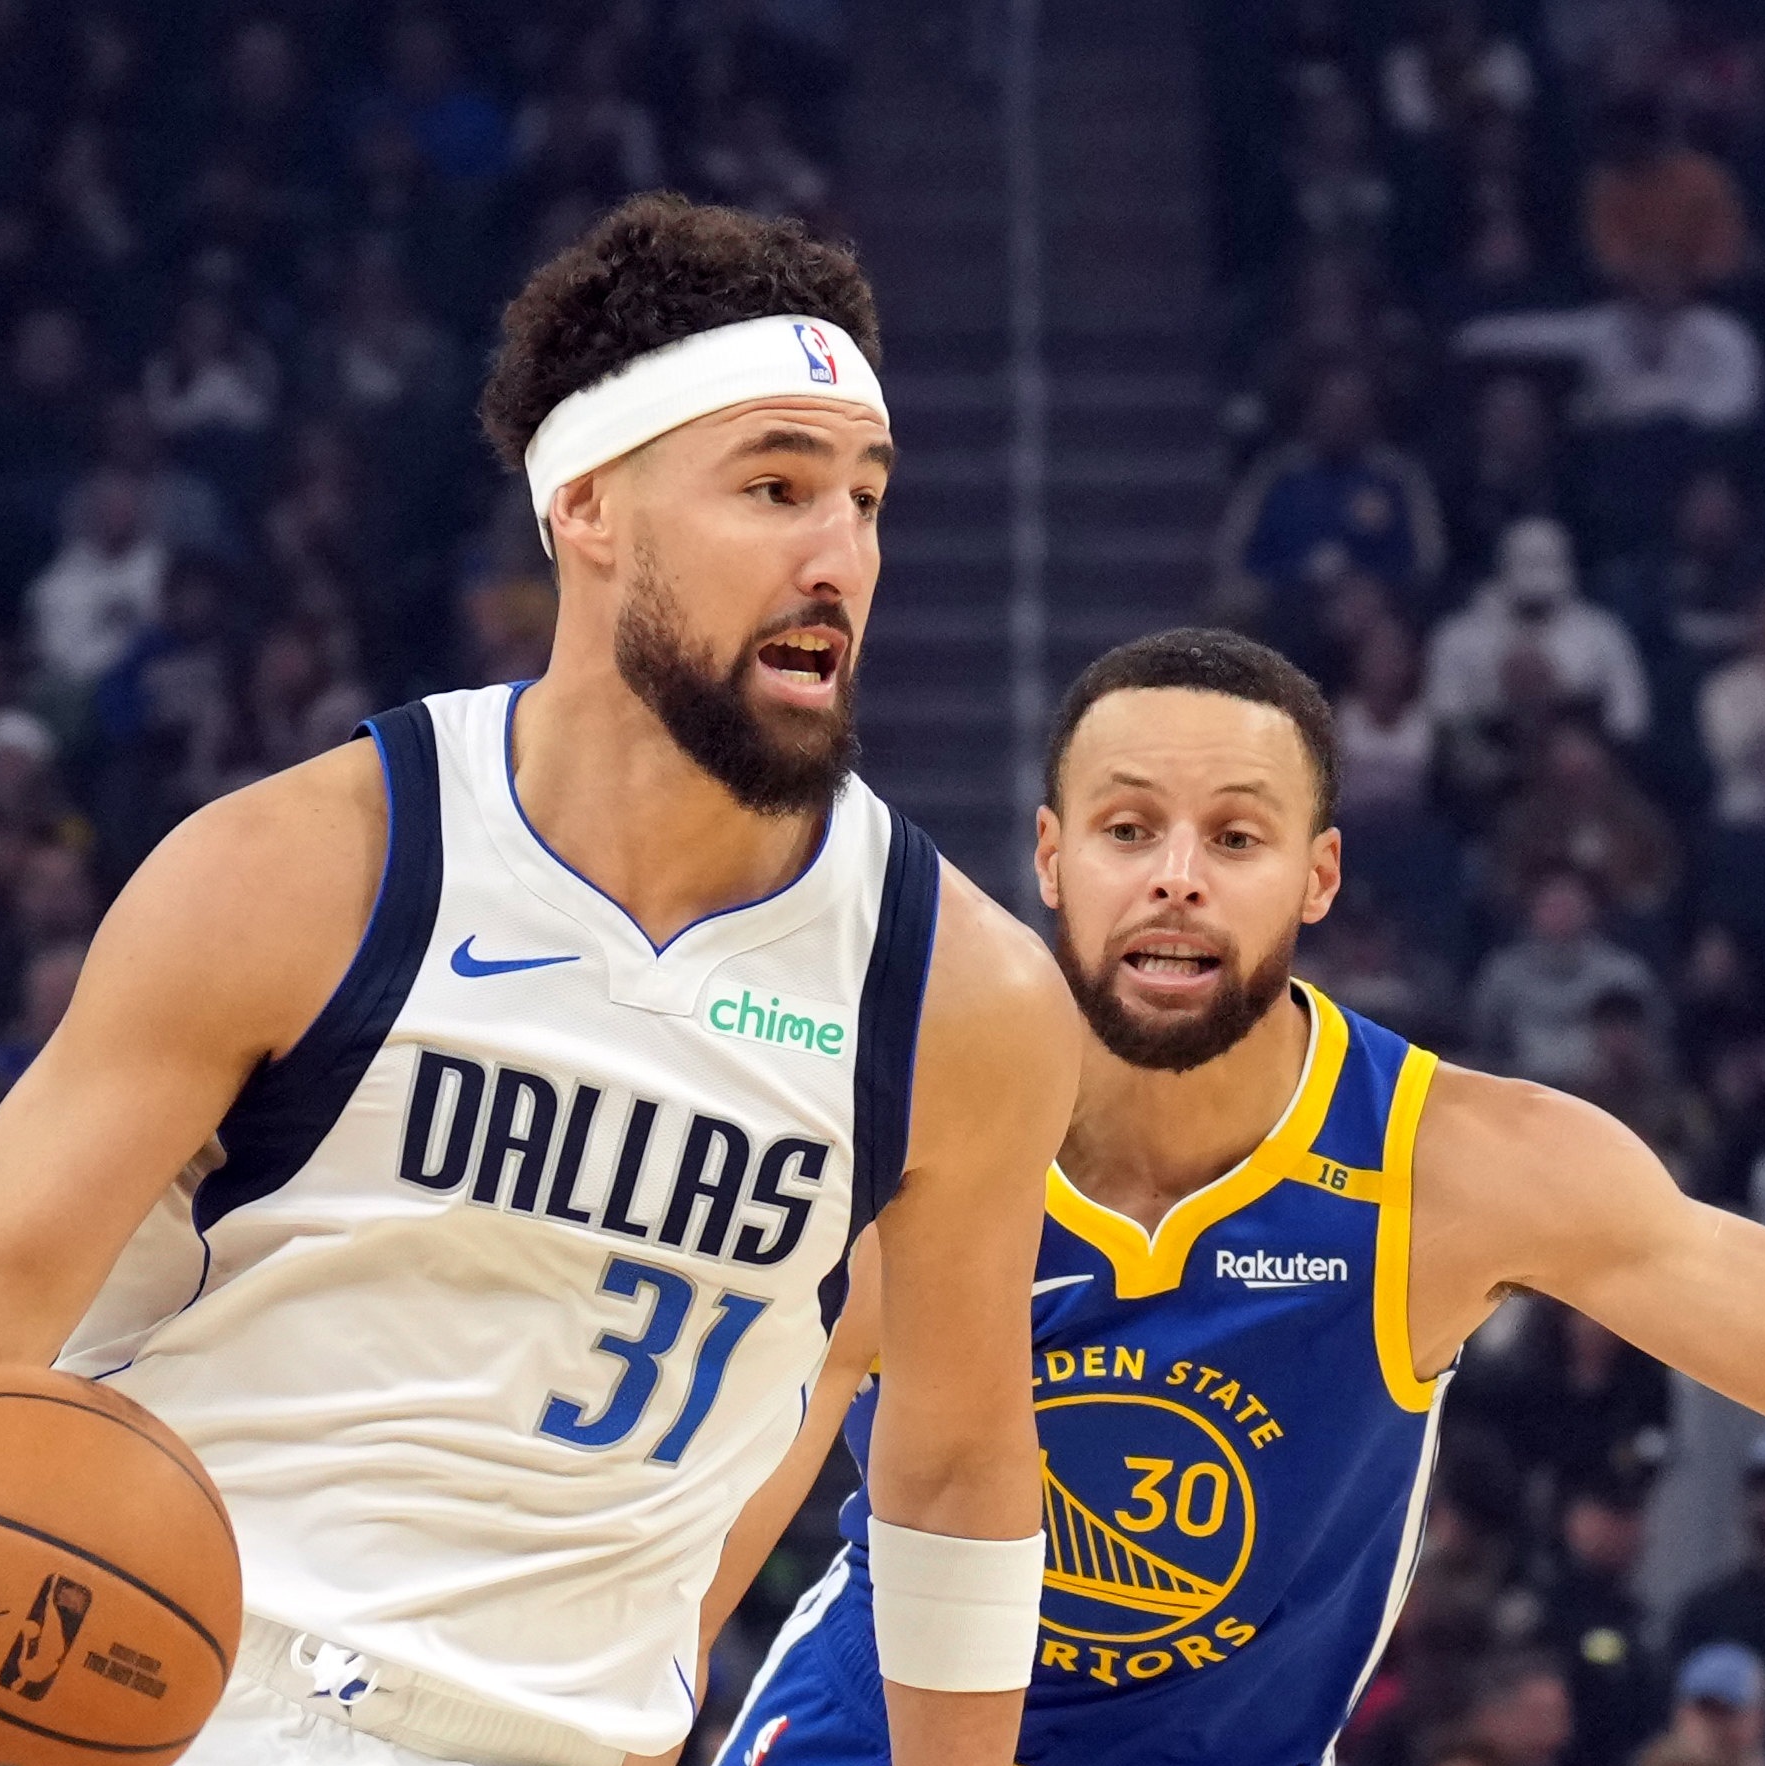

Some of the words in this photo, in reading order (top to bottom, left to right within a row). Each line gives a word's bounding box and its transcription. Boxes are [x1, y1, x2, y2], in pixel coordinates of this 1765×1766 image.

[709, 990, 845, 1056] chime
[396, 1044, 835, 1272] DALLAS
[1317, 1162, 1349, 1192] 16
[1215, 1249, 1348, 1285] Rakuten
[533, 1251, 774, 1470] 31
[1165, 1360, 1285, 1450] STATE
[1115, 1456, 1230, 1539] 30
[1040, 1616, 1257, 1687] RIORS
